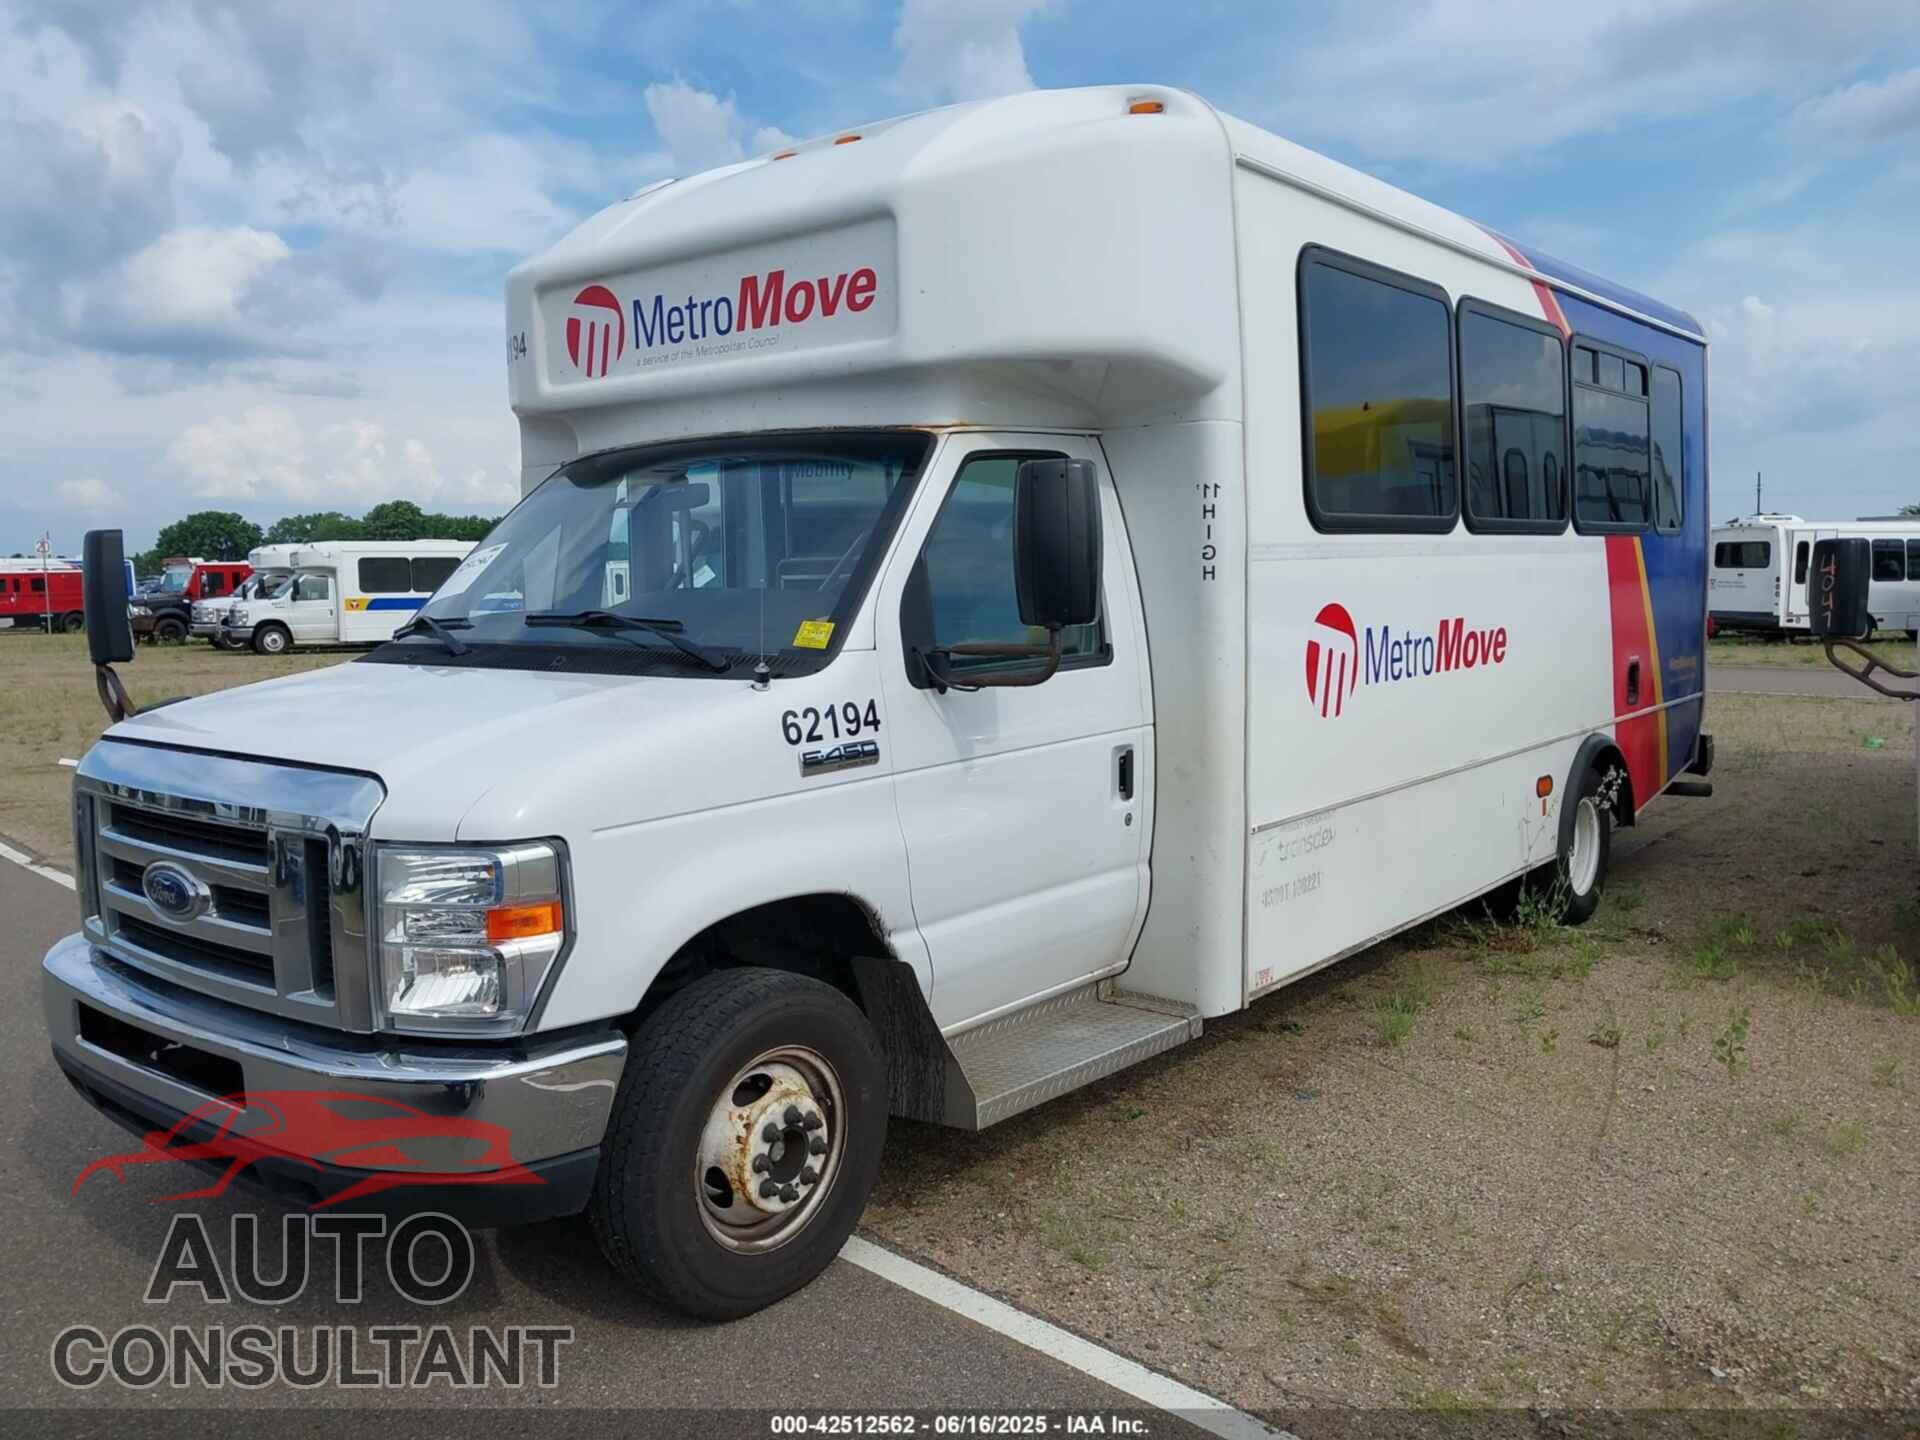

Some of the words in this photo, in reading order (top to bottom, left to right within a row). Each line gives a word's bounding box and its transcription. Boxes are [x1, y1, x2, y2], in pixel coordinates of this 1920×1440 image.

[632, 265, 877, 350] MetroMove
[696, 339, 746, 360] Metropolitan
[748, 333, 780, 350] Council
[1365, 617, 1507, 685] MetroMove
[782, 699, 880, 746] 62194
